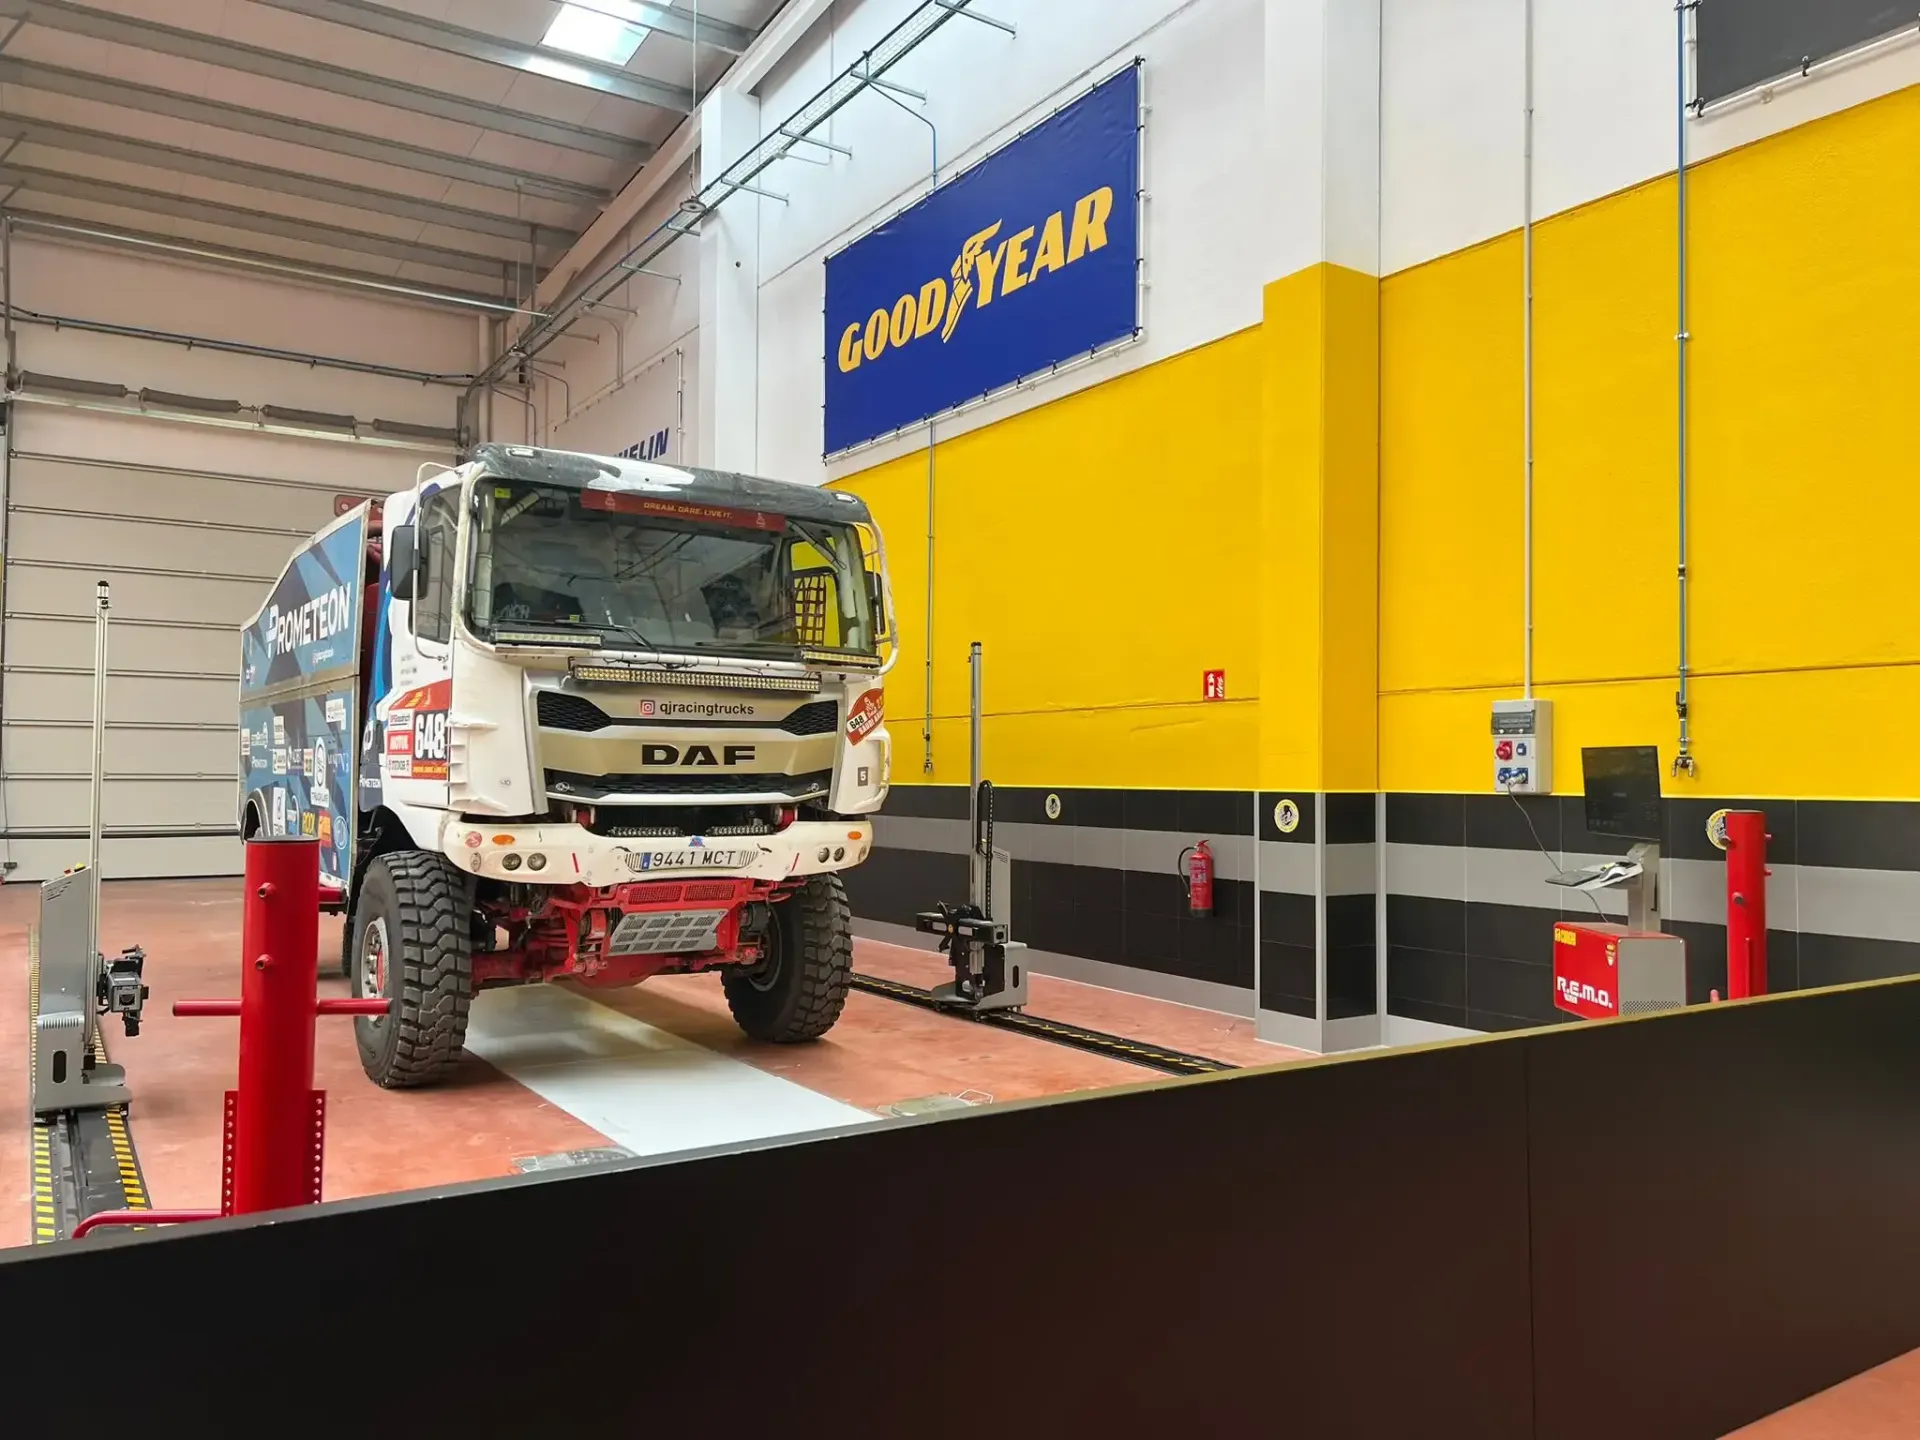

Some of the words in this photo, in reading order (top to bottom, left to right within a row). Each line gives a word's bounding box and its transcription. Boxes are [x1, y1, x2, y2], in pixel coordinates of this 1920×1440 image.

[837, 186, 1113, 373] GOODYEAR
[643, 502, 676, 512] DREAM.
[678, 506, 703, 515] DARE.
[704, 509, 722, 518] LIVE
[723, 511, 733, 519] IT.
[266, 581, 351, 659] PROMETEON
[660, 701, 755, 717] qjracingtrucks
[849, 714, 865, 730] 648
[414, 712, 446, 759] 648
[642, 744, 756, 766] DAF
[653, 851, 696, 867] 9441
[702, 850, 737, 865] MCT
